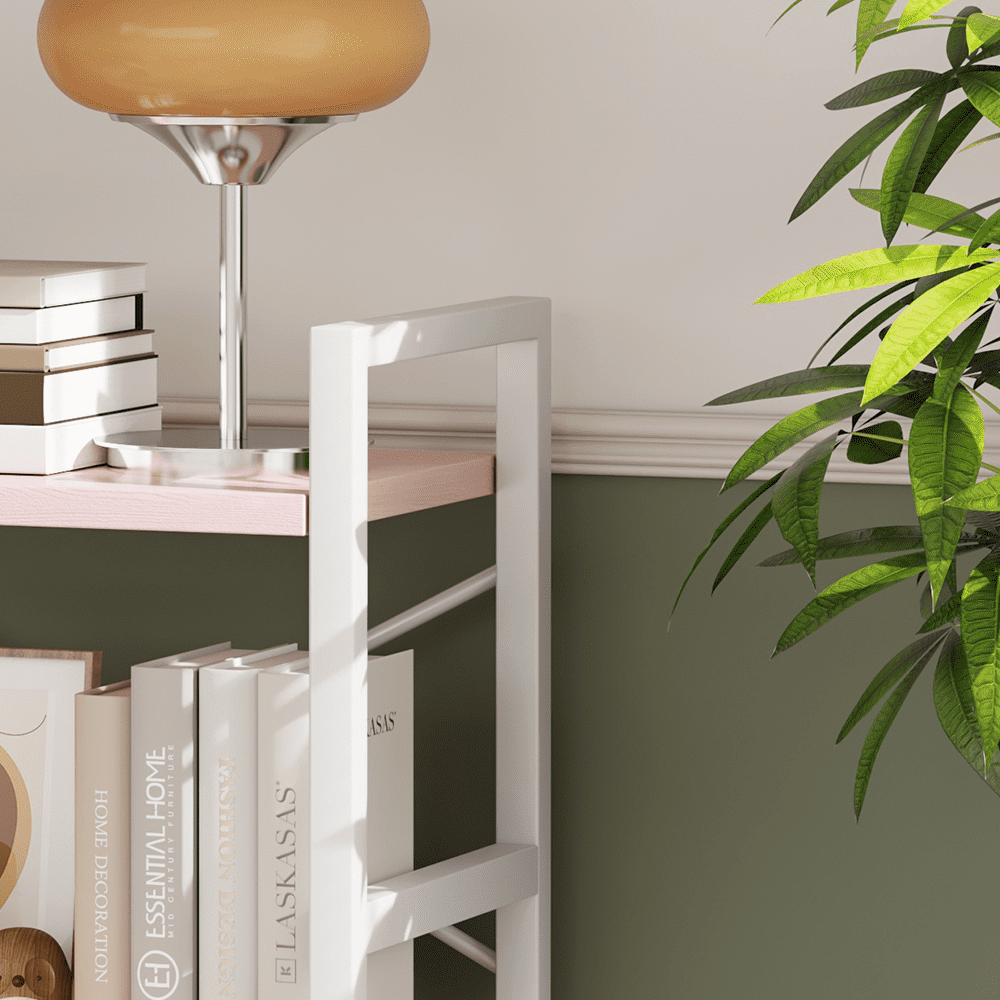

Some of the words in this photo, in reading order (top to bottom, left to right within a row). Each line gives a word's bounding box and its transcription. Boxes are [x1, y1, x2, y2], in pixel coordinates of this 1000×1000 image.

[367, 711, 395, 738] ASAS
[94, 789, 108, 849] HOME
[145, 747, 166, 820] HOME
[218, 757, 236, 883] FASHION
[94, 854, 108, 984] DECORATION
[145, 826, 166, 938] ESSENTIAL
[275, 787, 297, 952] LASKASAS
[218, 890, 236, 999] DESIGN
